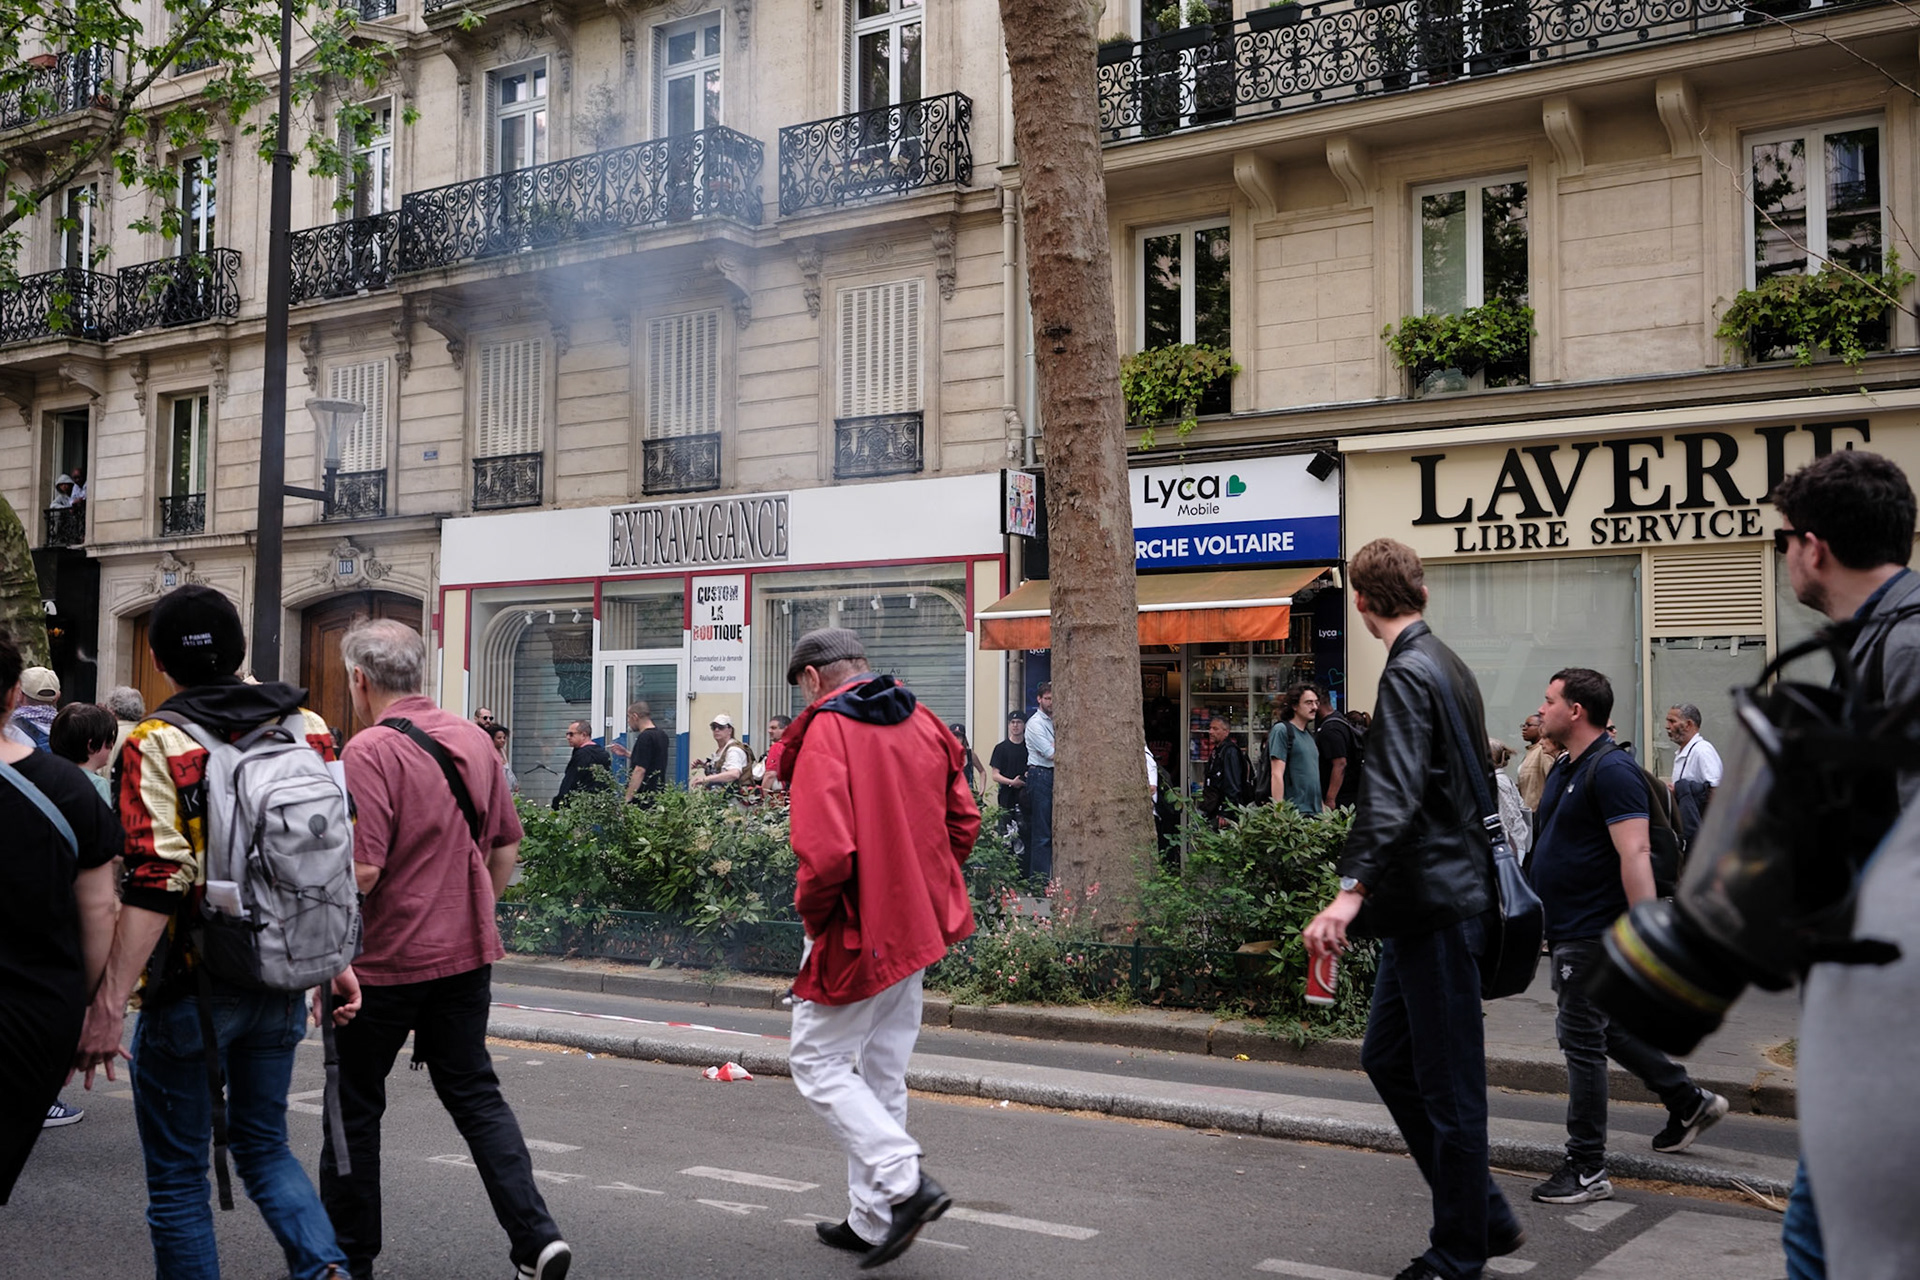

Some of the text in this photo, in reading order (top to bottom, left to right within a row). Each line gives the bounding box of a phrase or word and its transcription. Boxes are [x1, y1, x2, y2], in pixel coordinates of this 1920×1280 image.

[1143, 474, 1220, 509] Lyca
[1177, 502, 1220, 517] Mobile
[609, 497, 789, 568] EXTRAVAGANCE
[1453, 508, 1763, 554] LIBRE SERVICE
[1135, 530, 1295, 559] RCHE VOLTAIRE
[338, 560, 352, 574] 118
[711, 605, 723, 621] LA
[693, 624, 743, 643] BOUTIQUE
[1319, 629, 1338, 638] Lyca
